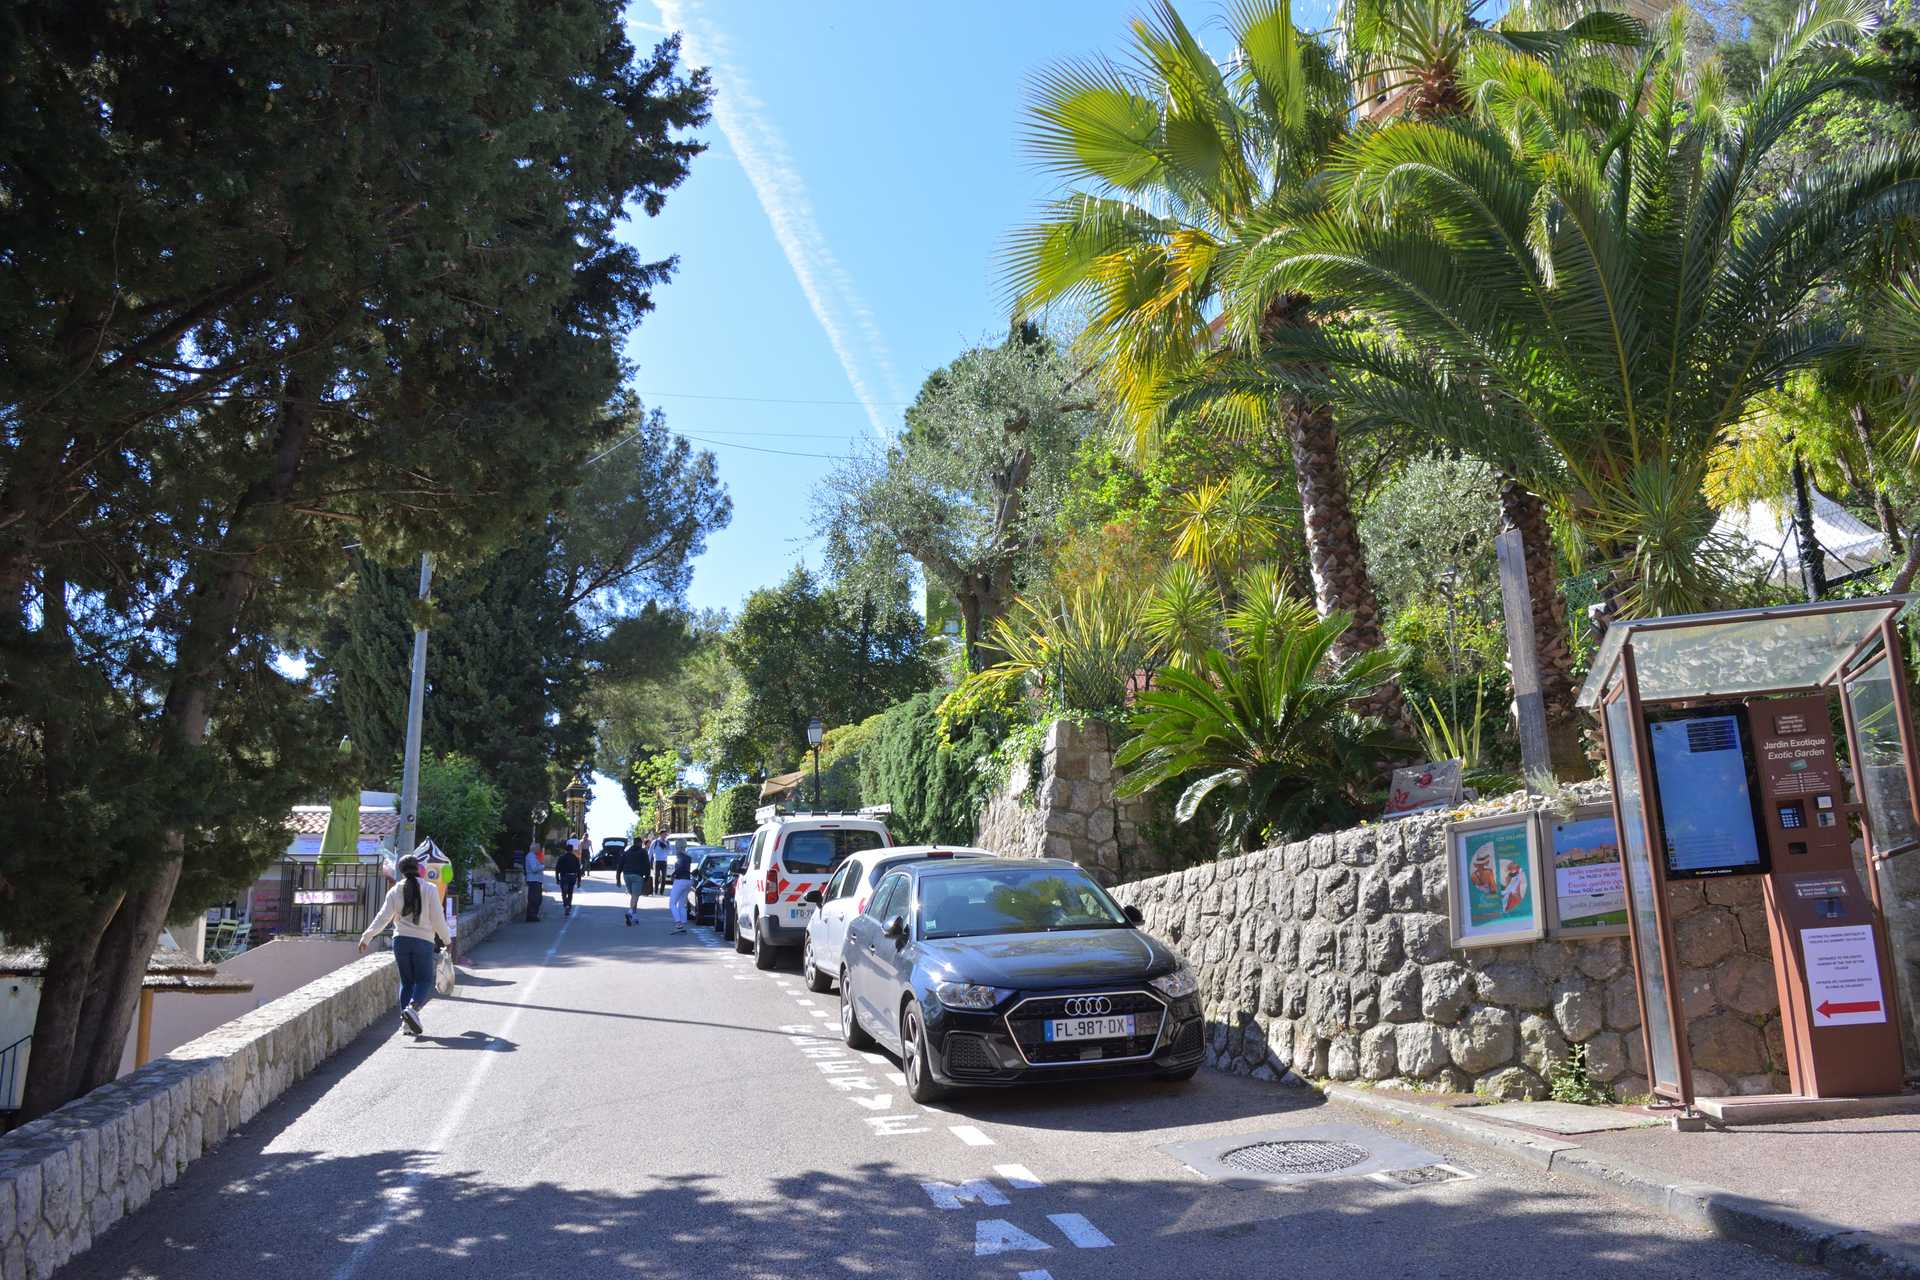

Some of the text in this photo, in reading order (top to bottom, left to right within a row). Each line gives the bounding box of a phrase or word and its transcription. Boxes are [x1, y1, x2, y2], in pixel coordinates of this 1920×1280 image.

[1763, 738, 1826, 750] Jardin Exotique
[1768, 748, 1825, 760] Exotic Garden
[1055, 1018, 1125, 1037] FL-987-DX
